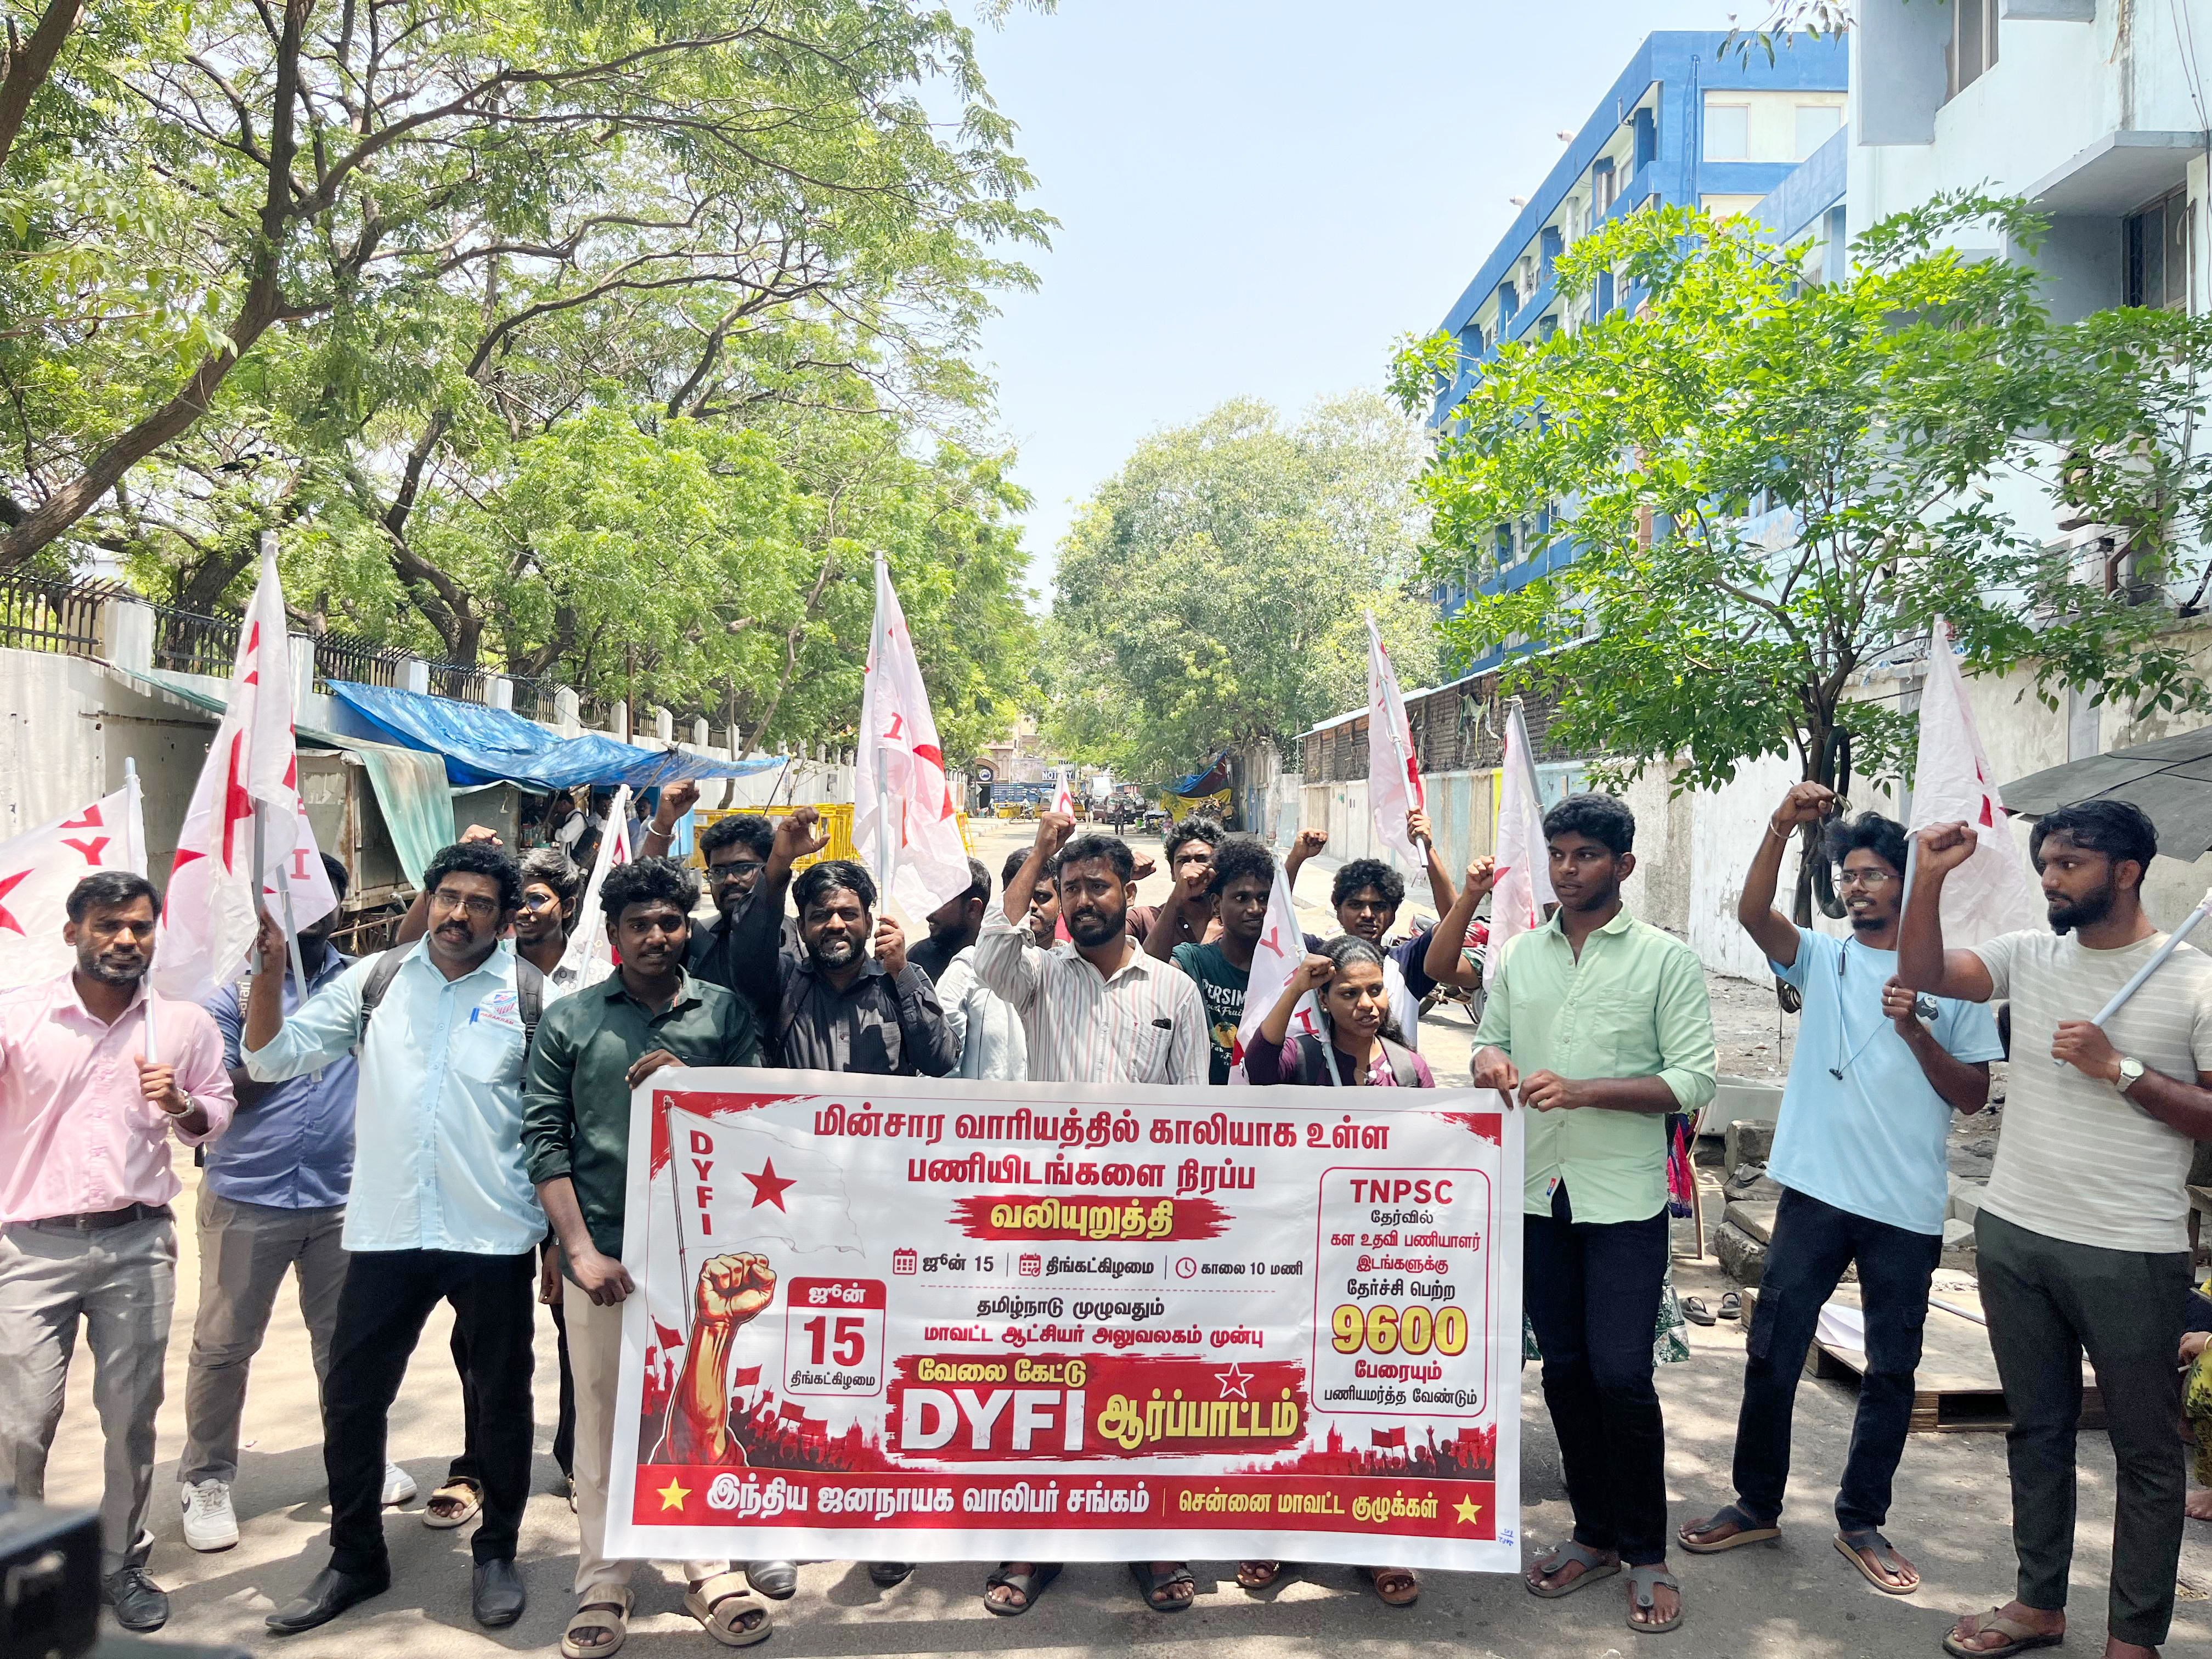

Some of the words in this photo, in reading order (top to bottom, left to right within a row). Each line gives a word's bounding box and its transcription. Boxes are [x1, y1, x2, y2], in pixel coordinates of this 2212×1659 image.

[1042, 771, 1073, 779] NOTY
[1202, 979, 1247, 1006] PERSIM
[1221, 1006, 1243, 1016] Frui
[814, 1102, 945, 1146] மின்சார
[955, 1108, 1139, 1149] வாரியத்தில்
[1150, 1112, 1296, 1147] காலியாக
[1307, 1115, 1389, 1149] உள்ள
[690, 1130, 714, 1235] DYFI
[908, 1152, 1165, 1187] பணியிடங்களை
[1176, 1158, 1255, 1195] நிரப்ப
[1350, 1180, 1453, 1204] TNPSC
[991, 1198, 1173, 1239] வலியுறுத்தி
[1371, 1209, 1434, 1226] தேர்வில்
[1361, 1230, 1398, 1249] உதவி
[1404, 1231, 1481, 1252] பணியாளர்
[923, 1253, 966, 1272] ஜூன்
[975, 1256, 994, 1272] 15
[1046, 1256, 1154, 1279] திங்கட்கிழமை
[1201, 1262, 1245, 1276] காலை
[1250, 1262, 1265, 1275] 10
[1271, 1261, 1303, 1276] மணி
[1356, 1254, 1448, 1274] இடங்களுக்கு
[808, 1282, 866, 1304] ஜூன்
[1347, 1278, 1404, 1300] தேர்ச்சி
[1410, 1279, 1455, 1301] பெற்ற
[977, 1295, 1063, 1319] தமிழ்நாடு
[1073, 1297, 1164, 1321] முழுவதும்
[804, 1316, 865, 1367] 15
[924, 1324, 993, 1341] மாவட்ட
[1001, 1323, 1085, 1348] ஆட்சியர்
[1092, 1324, 1202, 1348] அலுவலகம்
[1210, 1324, 1263, 1348] முன்பு
[1331, 1304, 1468, 1356] 9600
[791, 1370, 875, 1390] திங்கட்கிழமை
[918, 1358, 1007, 1382] வேலை
[1014, 1358, 1087, 1388] கேட்டு
[1355, 1359, 1442, 1384] பேரையும்
[1324, 1385, 1407, 1406] பணியமர்த்த
[1413, 1387, 1477, 1407] வேண்டும்
[901, 1388, 1086, 1451] DYFI
[1097, 1387, 1299, 1450] ஆர்ப்பாட்டம்
[707, 1472, 808, 1519] இந்திய
[817, 1486, 955, 1521] ஜனநாயக
[963, 1481, 1059, 1513] வாலிபர்
[1066, 1480, 1149, 1513] சங்கம்
[1179, 1487, 1272, 1514] சென்னை
[1278, 1493, 1345, 1515] மாவட்ட
[1352, 1490, 1438, 1523] குழுக்கள்
